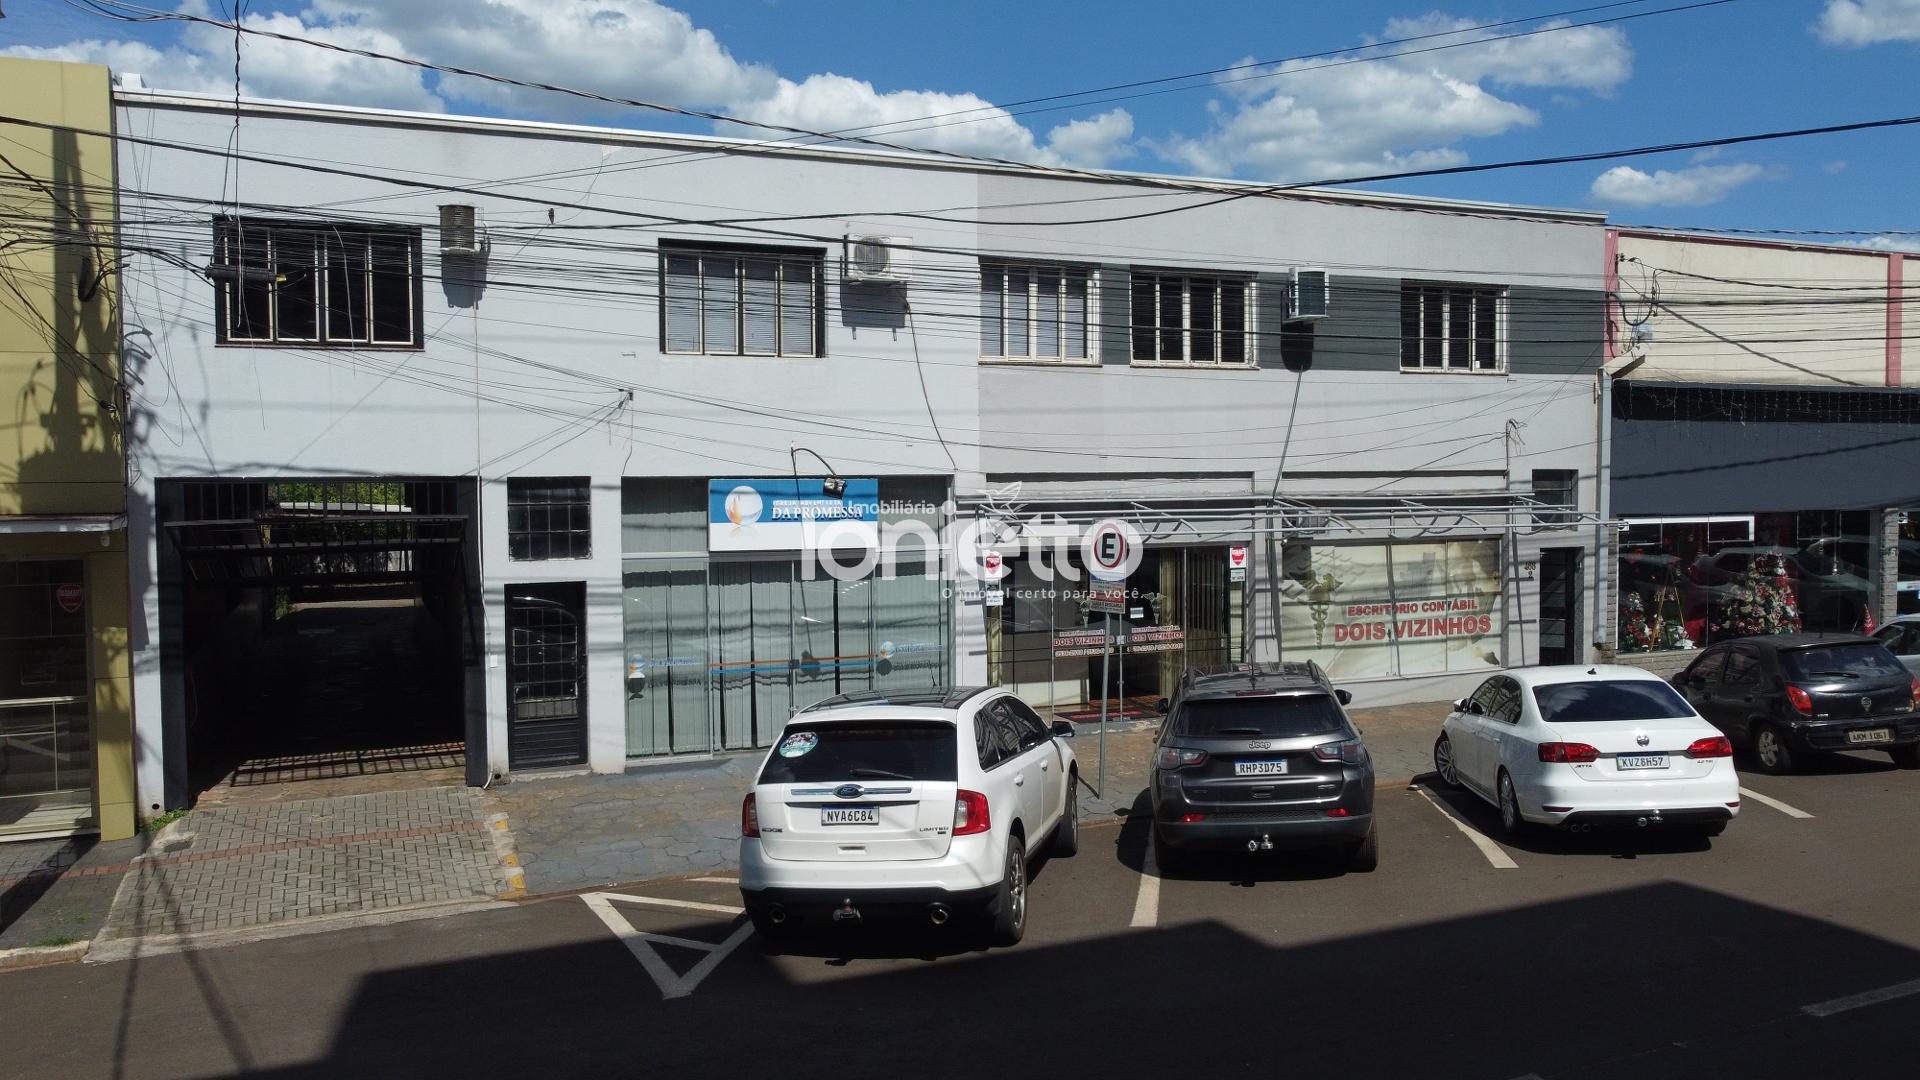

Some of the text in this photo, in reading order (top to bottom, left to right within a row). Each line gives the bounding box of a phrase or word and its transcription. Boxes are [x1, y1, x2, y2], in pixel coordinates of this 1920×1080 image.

[773, 506, 863, 520] DA PROMESSA
[1101, 533, 1116, 559] E
[1335, 614, 1491, 642] DOIS VIZINHOS
[1054, 635, 1115, 646] DOIS VIZINHS
[1249, 740, 1272, 749] Jeep
[1239, 763, 1281, 774] RHP3D75
[827, 808, 873, 822] NYA6C84
